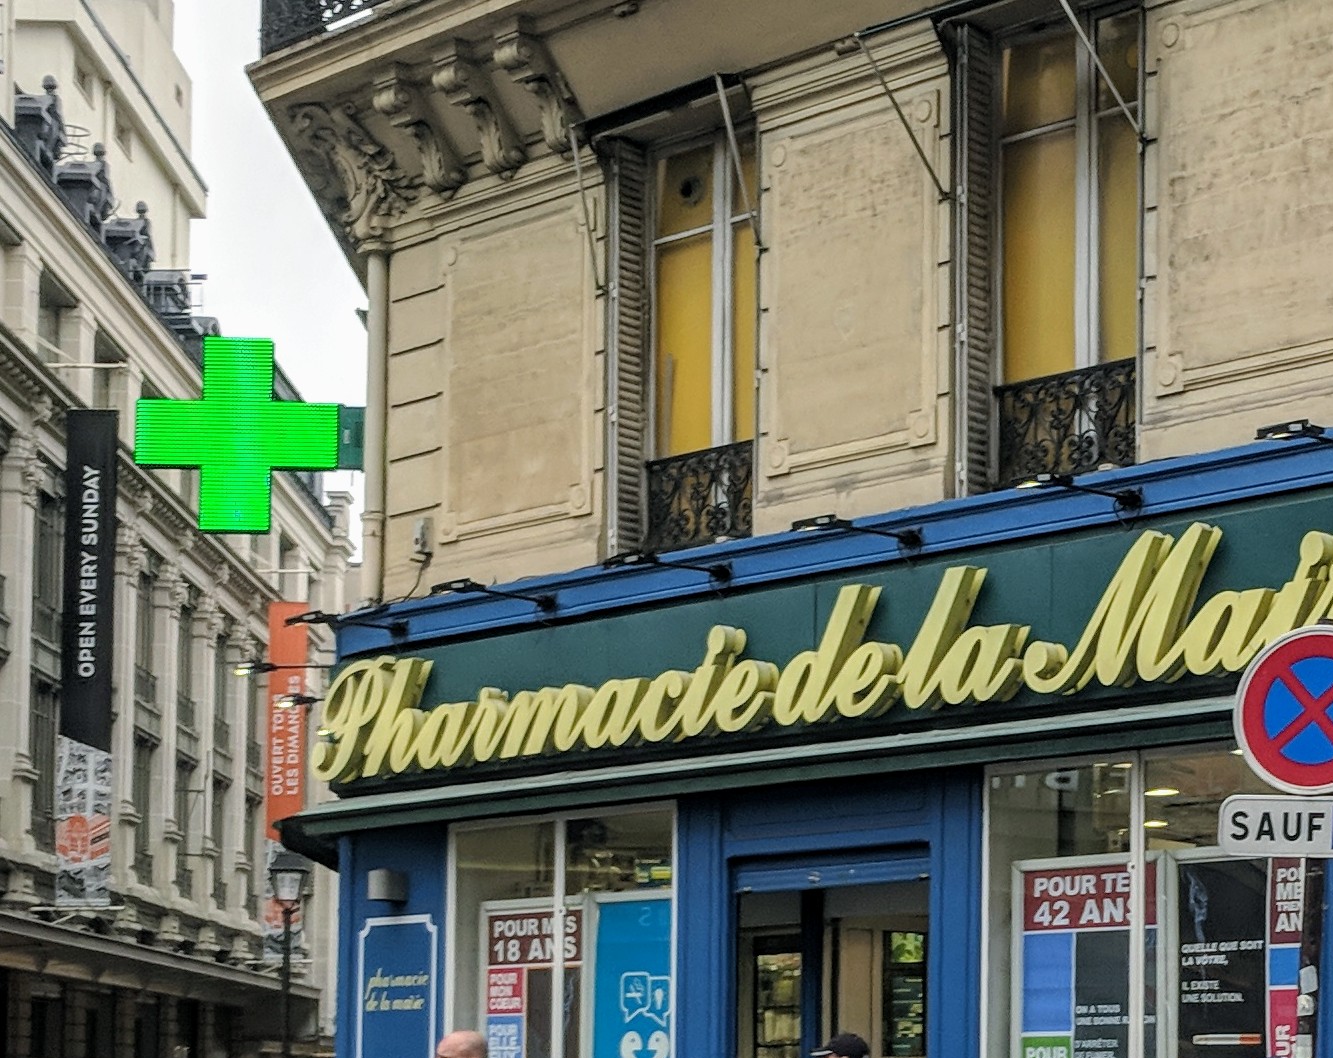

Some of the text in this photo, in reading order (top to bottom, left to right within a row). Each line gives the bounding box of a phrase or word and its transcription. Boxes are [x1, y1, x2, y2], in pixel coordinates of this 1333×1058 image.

[78, 465, 101, 678] OPEN EVERY SUNDAY
[310, 625, 780, 784] Pharmacie
[774, 583, 906, 728] de
[900, 565, 1031, 711] la
[271, 737, 285, 796] OUVERT
[286, 768, 299, 795] LES
[1230, 810, 1326, 842] SAUF
[1033, 872, 1131, 898] POUR TE
[1033, 899, 1071, 926] 42
[494, 916, 577, 938] POUR MS
[493, 939, 521, 962] 18
[365, 967, 429, 999] pharmacie
[366, 992, 378, 1012] de
